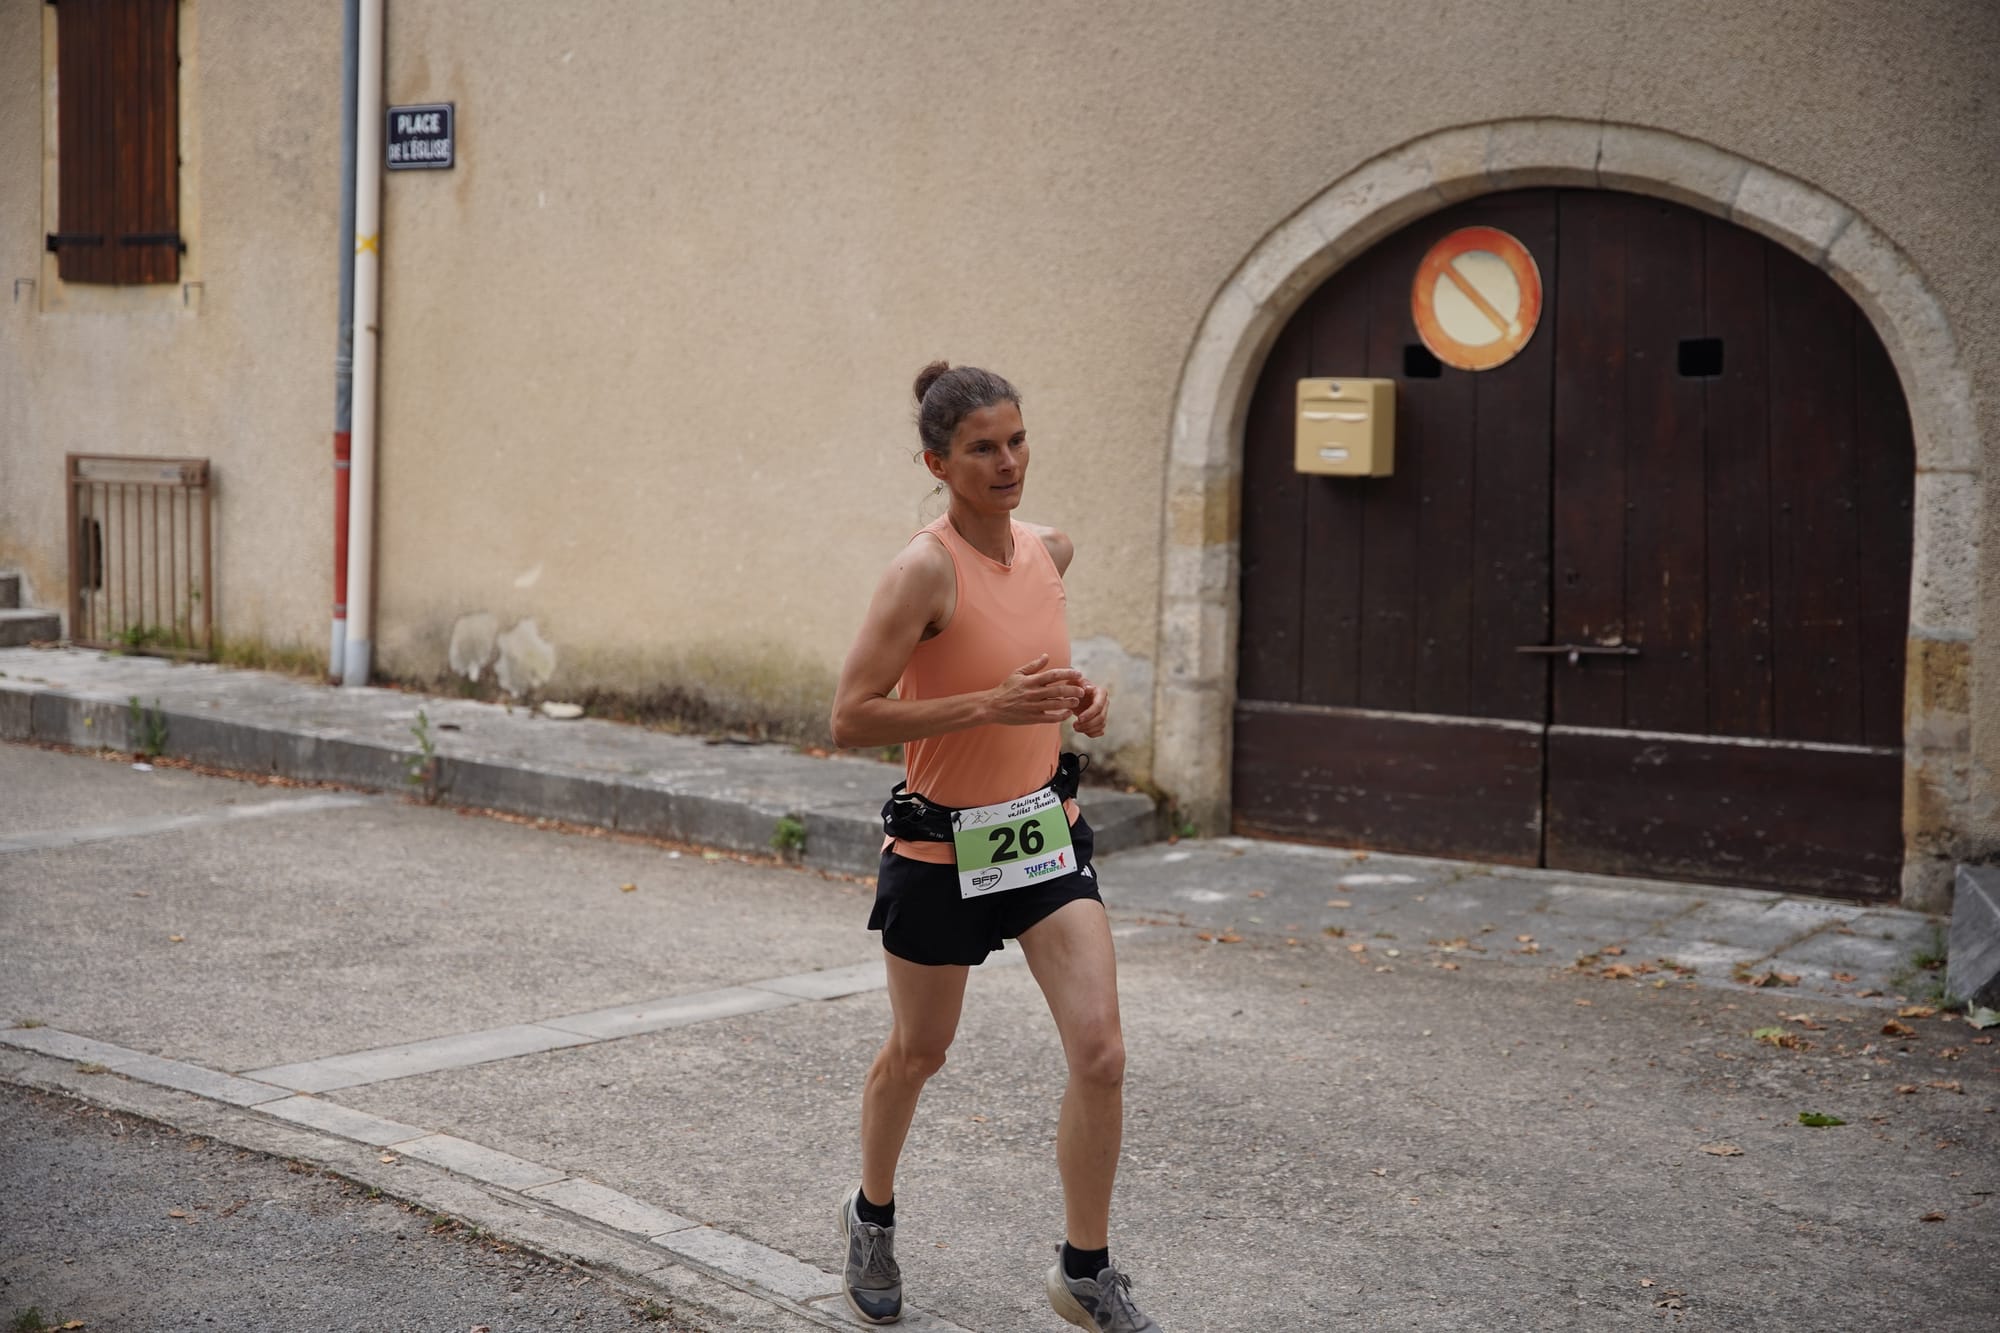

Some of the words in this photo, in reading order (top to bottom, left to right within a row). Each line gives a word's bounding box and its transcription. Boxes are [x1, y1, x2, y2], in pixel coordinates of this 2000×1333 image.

[397, 112, 441, 135] PLACE
[388, 143, 401, 161] DE
[1011, 796, 1041, 810] Challenge
[989, 819, 1044, 863] 26
[1024, 859, 1056, 875] TUFF'S
[972, 874, 999, 886] BFP
